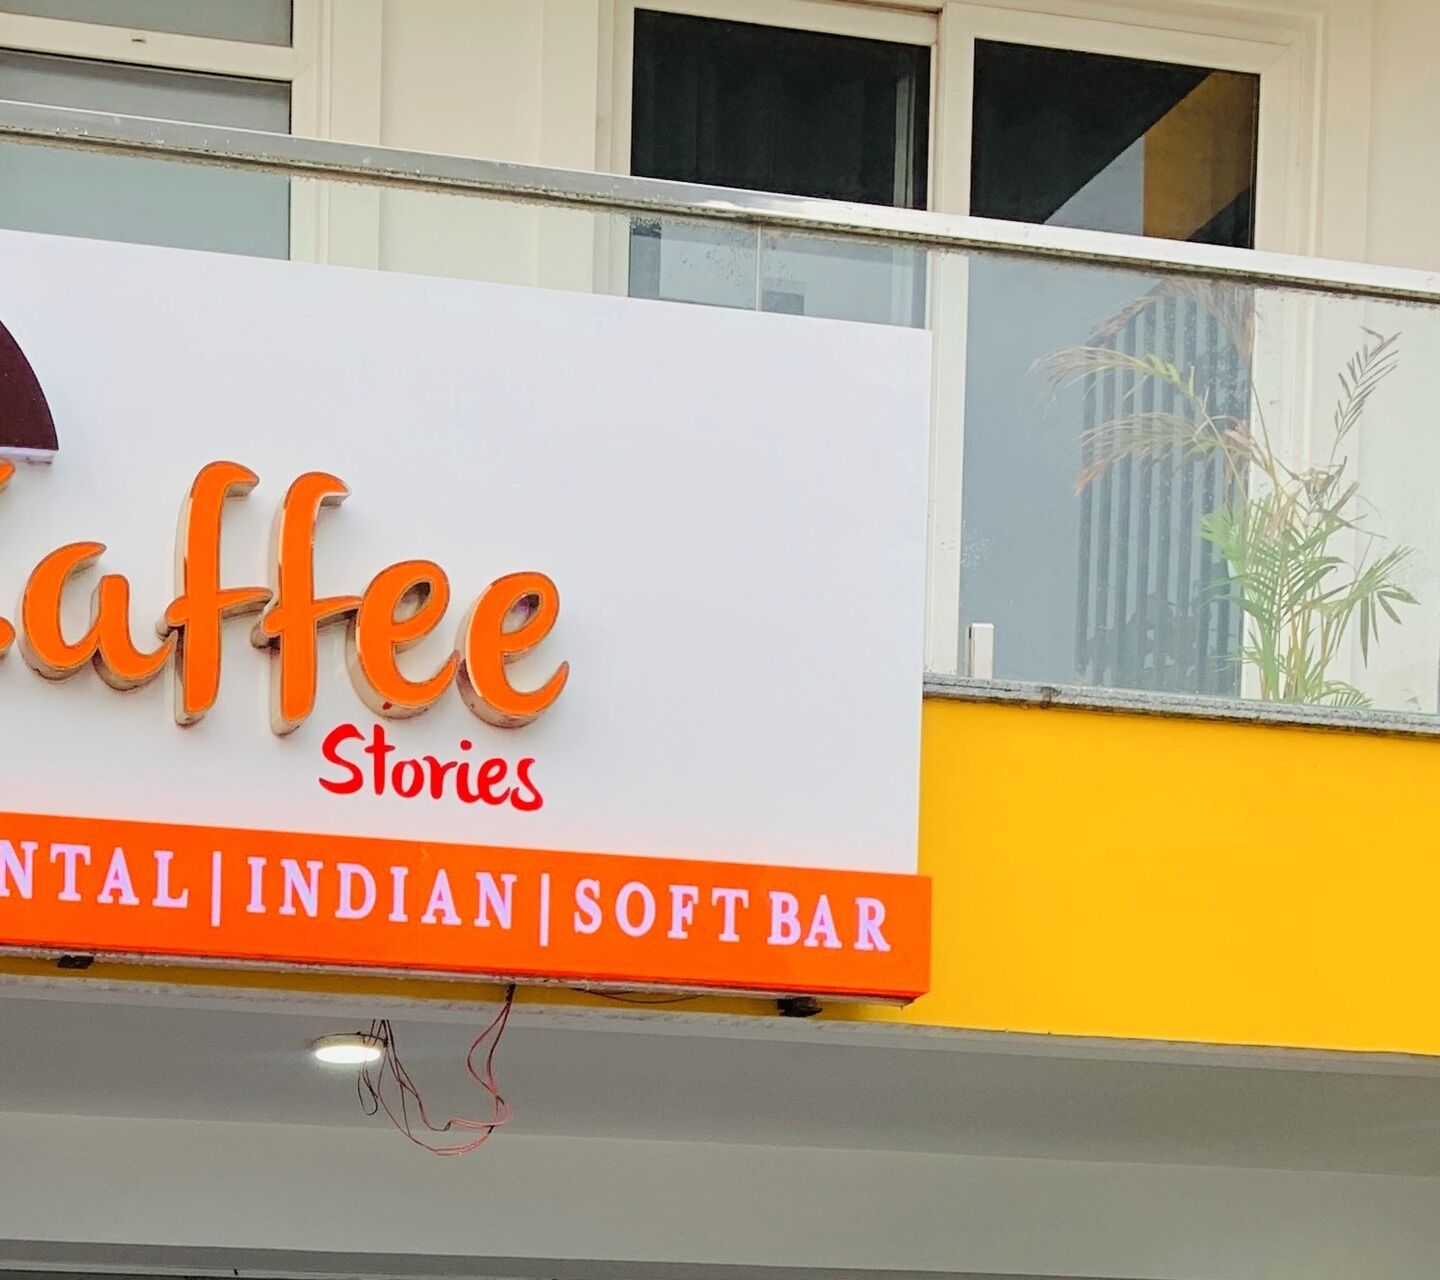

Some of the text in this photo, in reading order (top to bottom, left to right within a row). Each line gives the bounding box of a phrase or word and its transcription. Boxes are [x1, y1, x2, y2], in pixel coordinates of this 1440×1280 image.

[319, 722, 545, 812] Stories
[247, 856, 517, 929] INDIAN
[573, 878, 749, 942] SOFT
[767, 891, 891, 953] BAR
